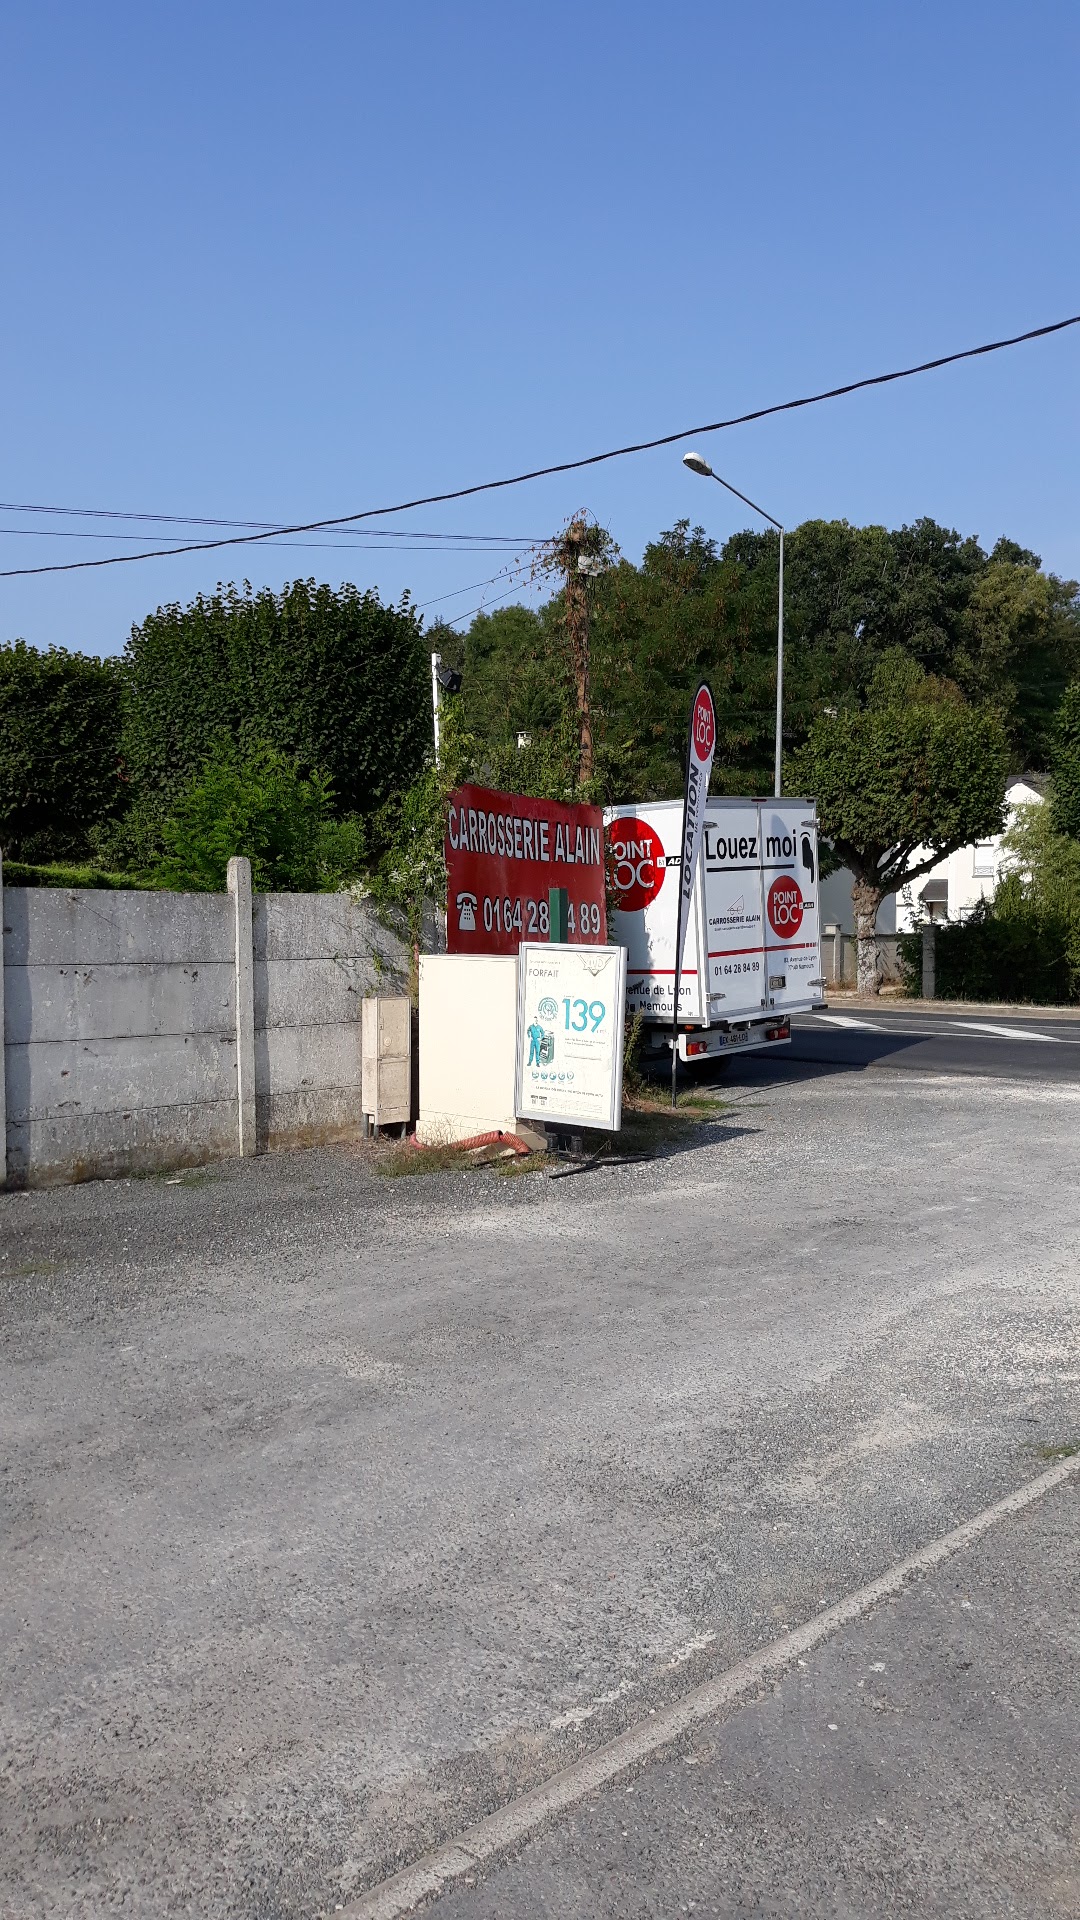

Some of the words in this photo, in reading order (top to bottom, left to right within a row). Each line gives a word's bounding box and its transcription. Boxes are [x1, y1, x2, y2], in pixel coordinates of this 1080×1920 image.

[697, 704, 711, 724] POINT
[696, 719, 711, 747] LOC
[448, 805, 550, 861] CARROSSERIE
[555, 823, 600, 865] ALAIN
[683, 762, 700, 900] LOCATION
[613, 838, 653, 861] OINT
[704, 830, 757, 860] Louez
[766, 829, 797, 859] moi
[613, 859, 655, 890] OC
[773, 890, 798, 905] POINT
[527, 900, 550, 935] 28
[580, 903, 600, 935] 89
[708, 915, 745, 926] CARROSSERIE
[745, 914, 761, 923] ALAIN
[773, 903, 799, 925] LOC
[528, 968, 560, 978] FORFAIT
[714, 965, 722, 976] 01
[723, 964, 732, 975] 64
[733, 963, 742, 974] 28
[743, 962, 751, 973] 84
[752, 961, 760, 972] 89
[653, 984, 665, 995] de
[562, 998, 606, 1033] 139
[640, 1000, 683, 1012] Nemous
